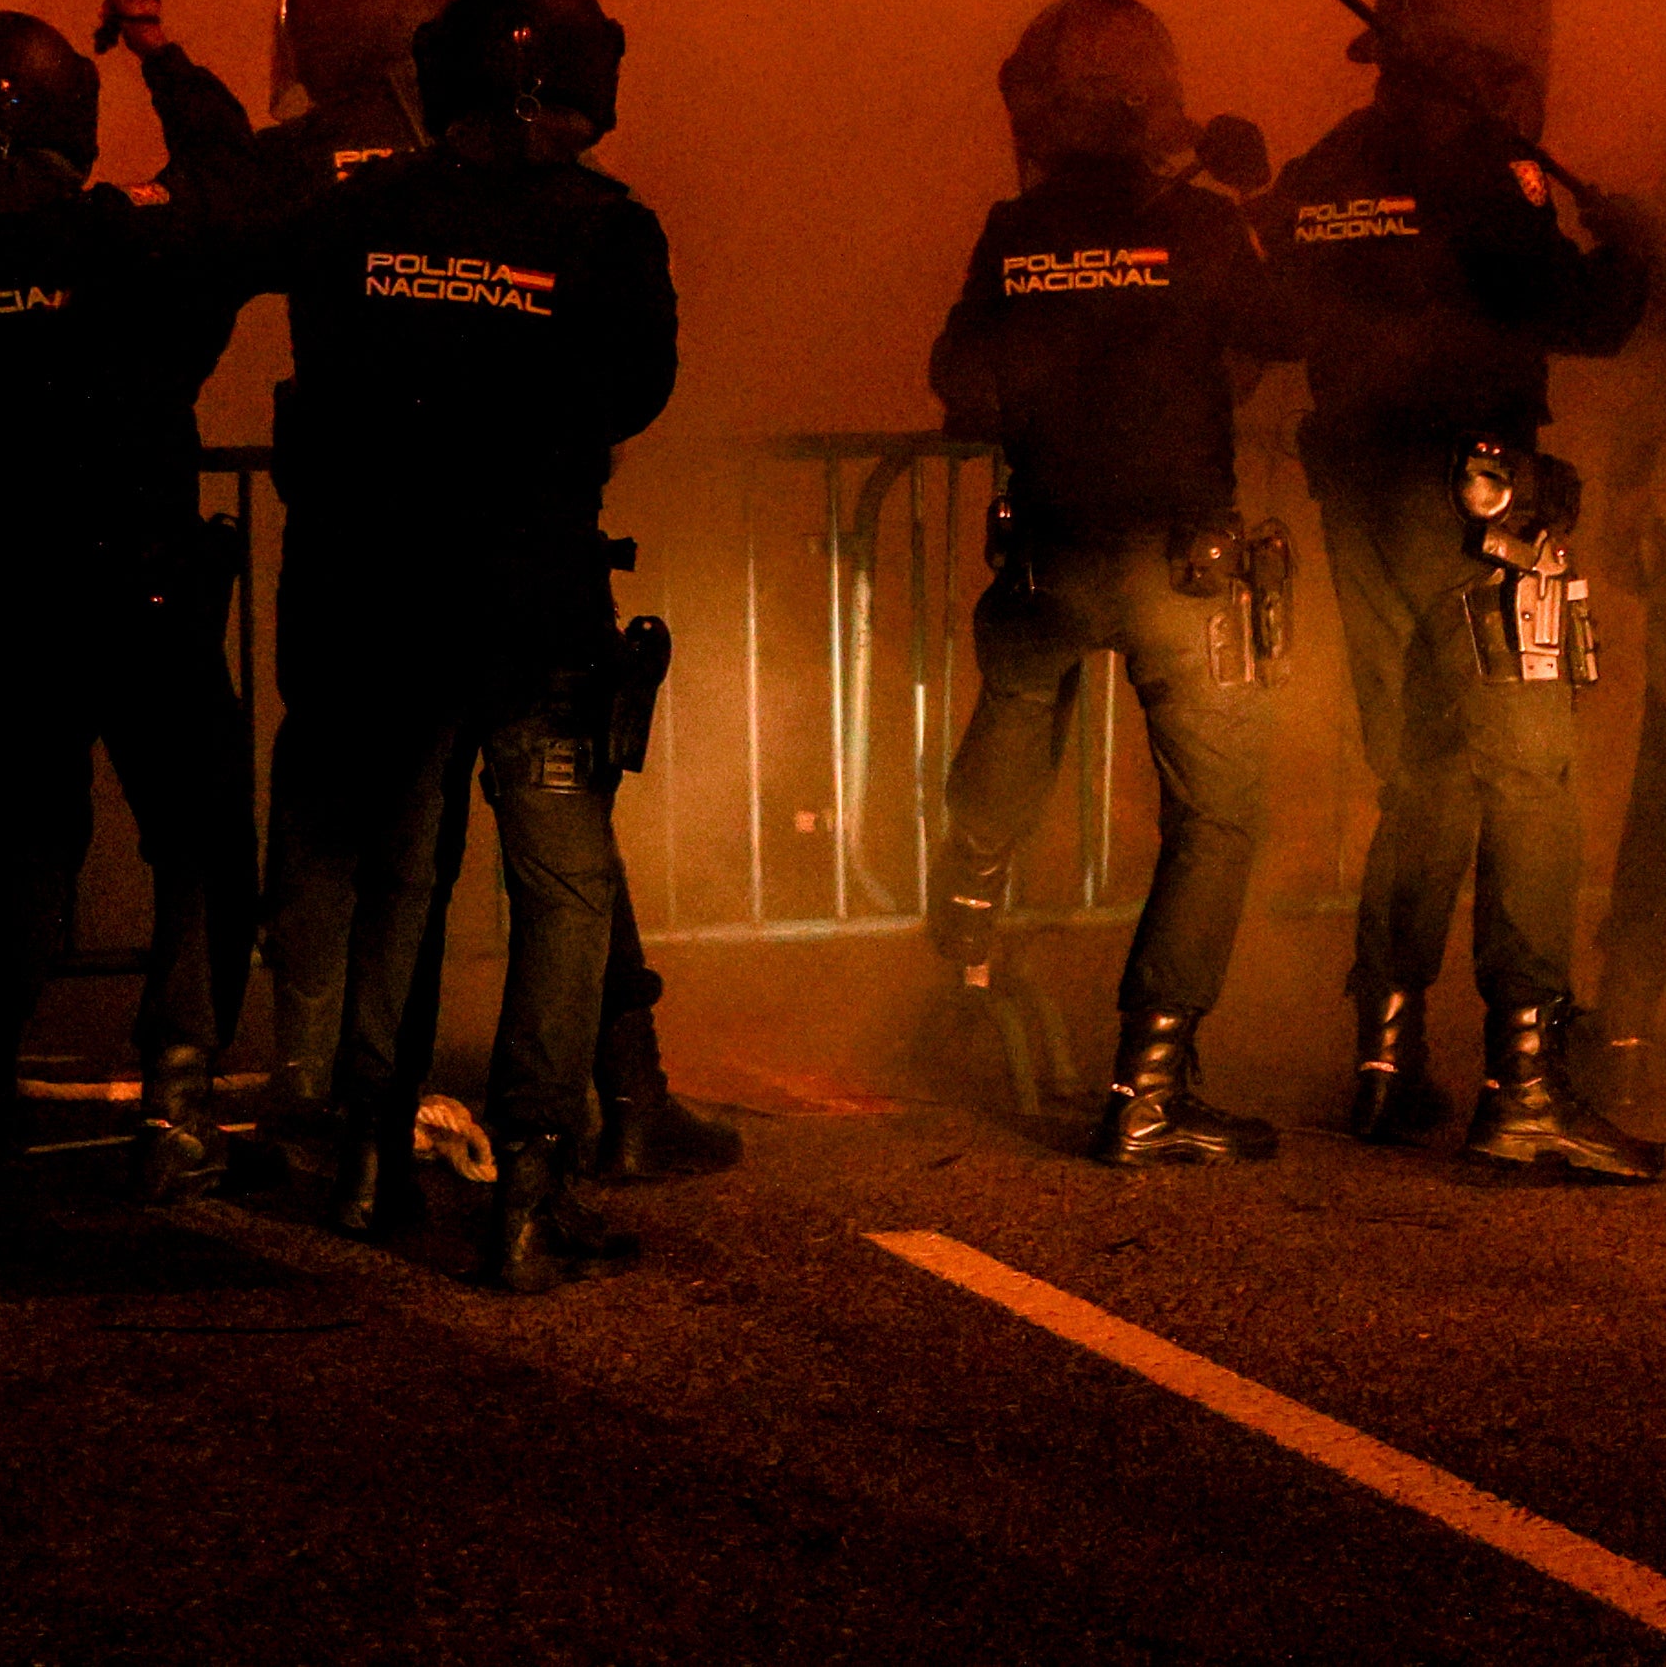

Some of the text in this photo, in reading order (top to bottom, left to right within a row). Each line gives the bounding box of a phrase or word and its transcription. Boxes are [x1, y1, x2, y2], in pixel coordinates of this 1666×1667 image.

[1295, 214, 1420, 243] NACIONAL
[366, 251, 513, 285] POLICIA
[1003, 249, 1133, 277] POLICIA
[365, 275, 553, 317] NACIONAL
[1003, 266, 1170, 297] NACIONAL
